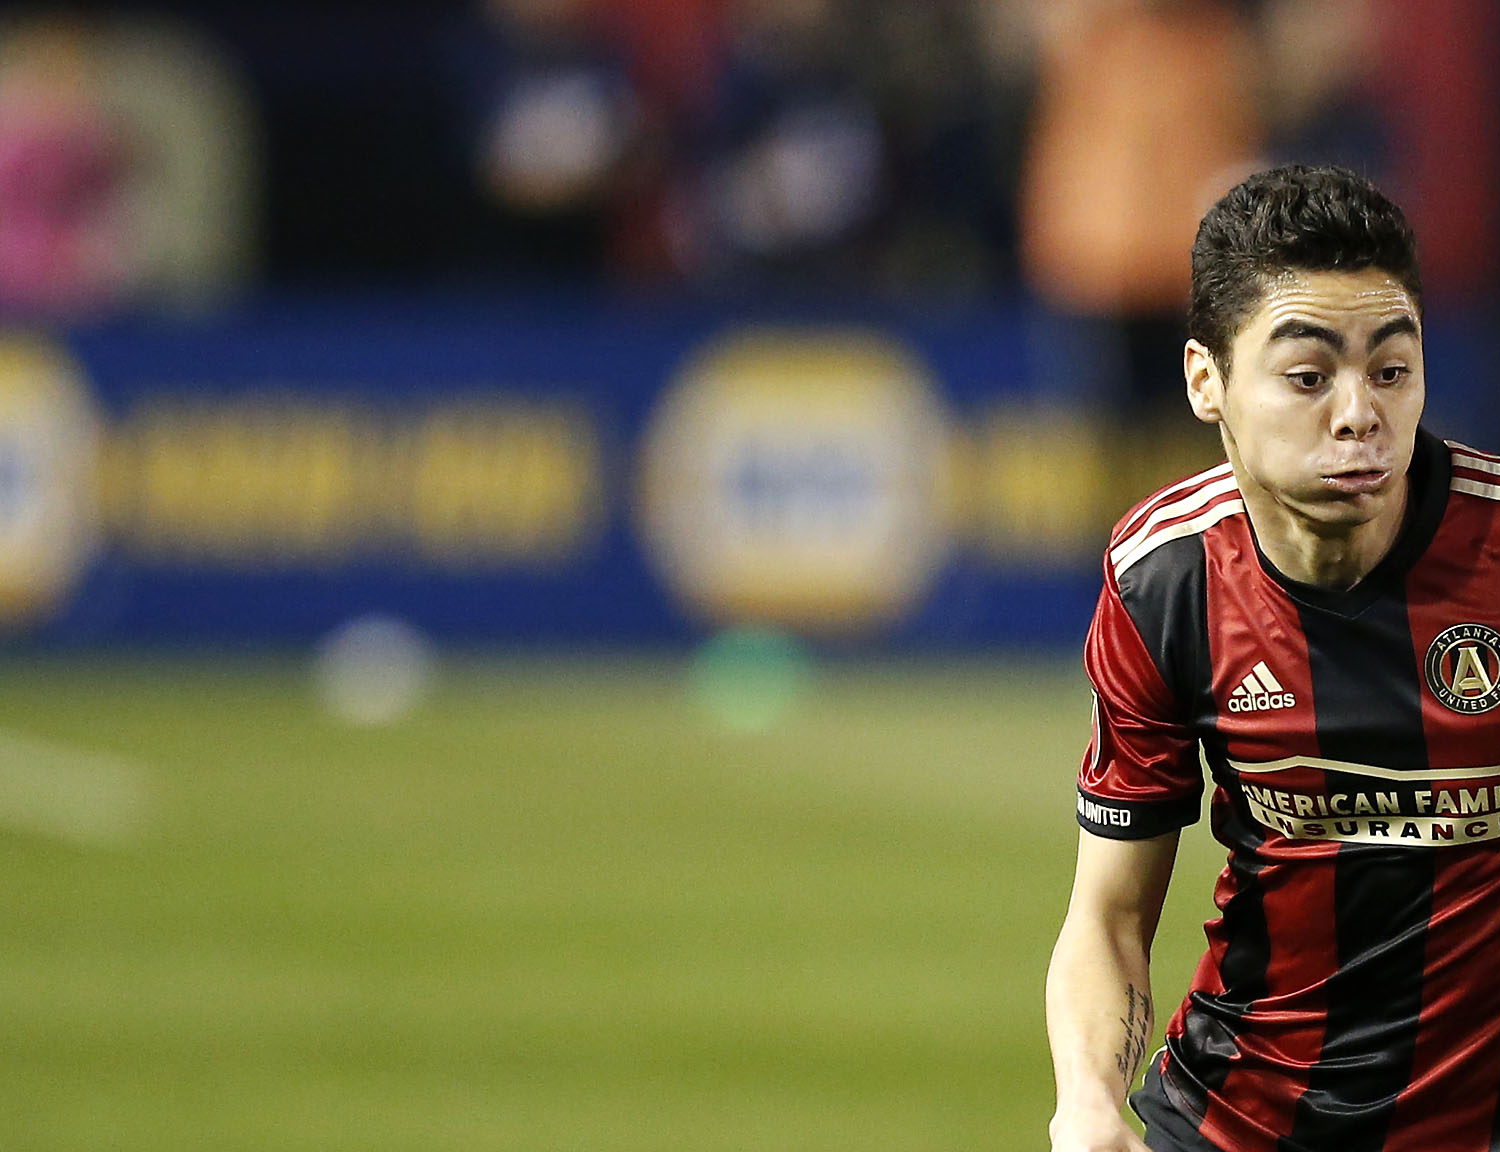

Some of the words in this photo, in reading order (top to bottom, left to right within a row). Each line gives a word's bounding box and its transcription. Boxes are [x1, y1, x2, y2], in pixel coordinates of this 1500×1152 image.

[1436, 628, 1499, 652] ATLANTA
[1228, 692, 1296, 713] adidas
[1438, 688, 1488, 710] UNITED
